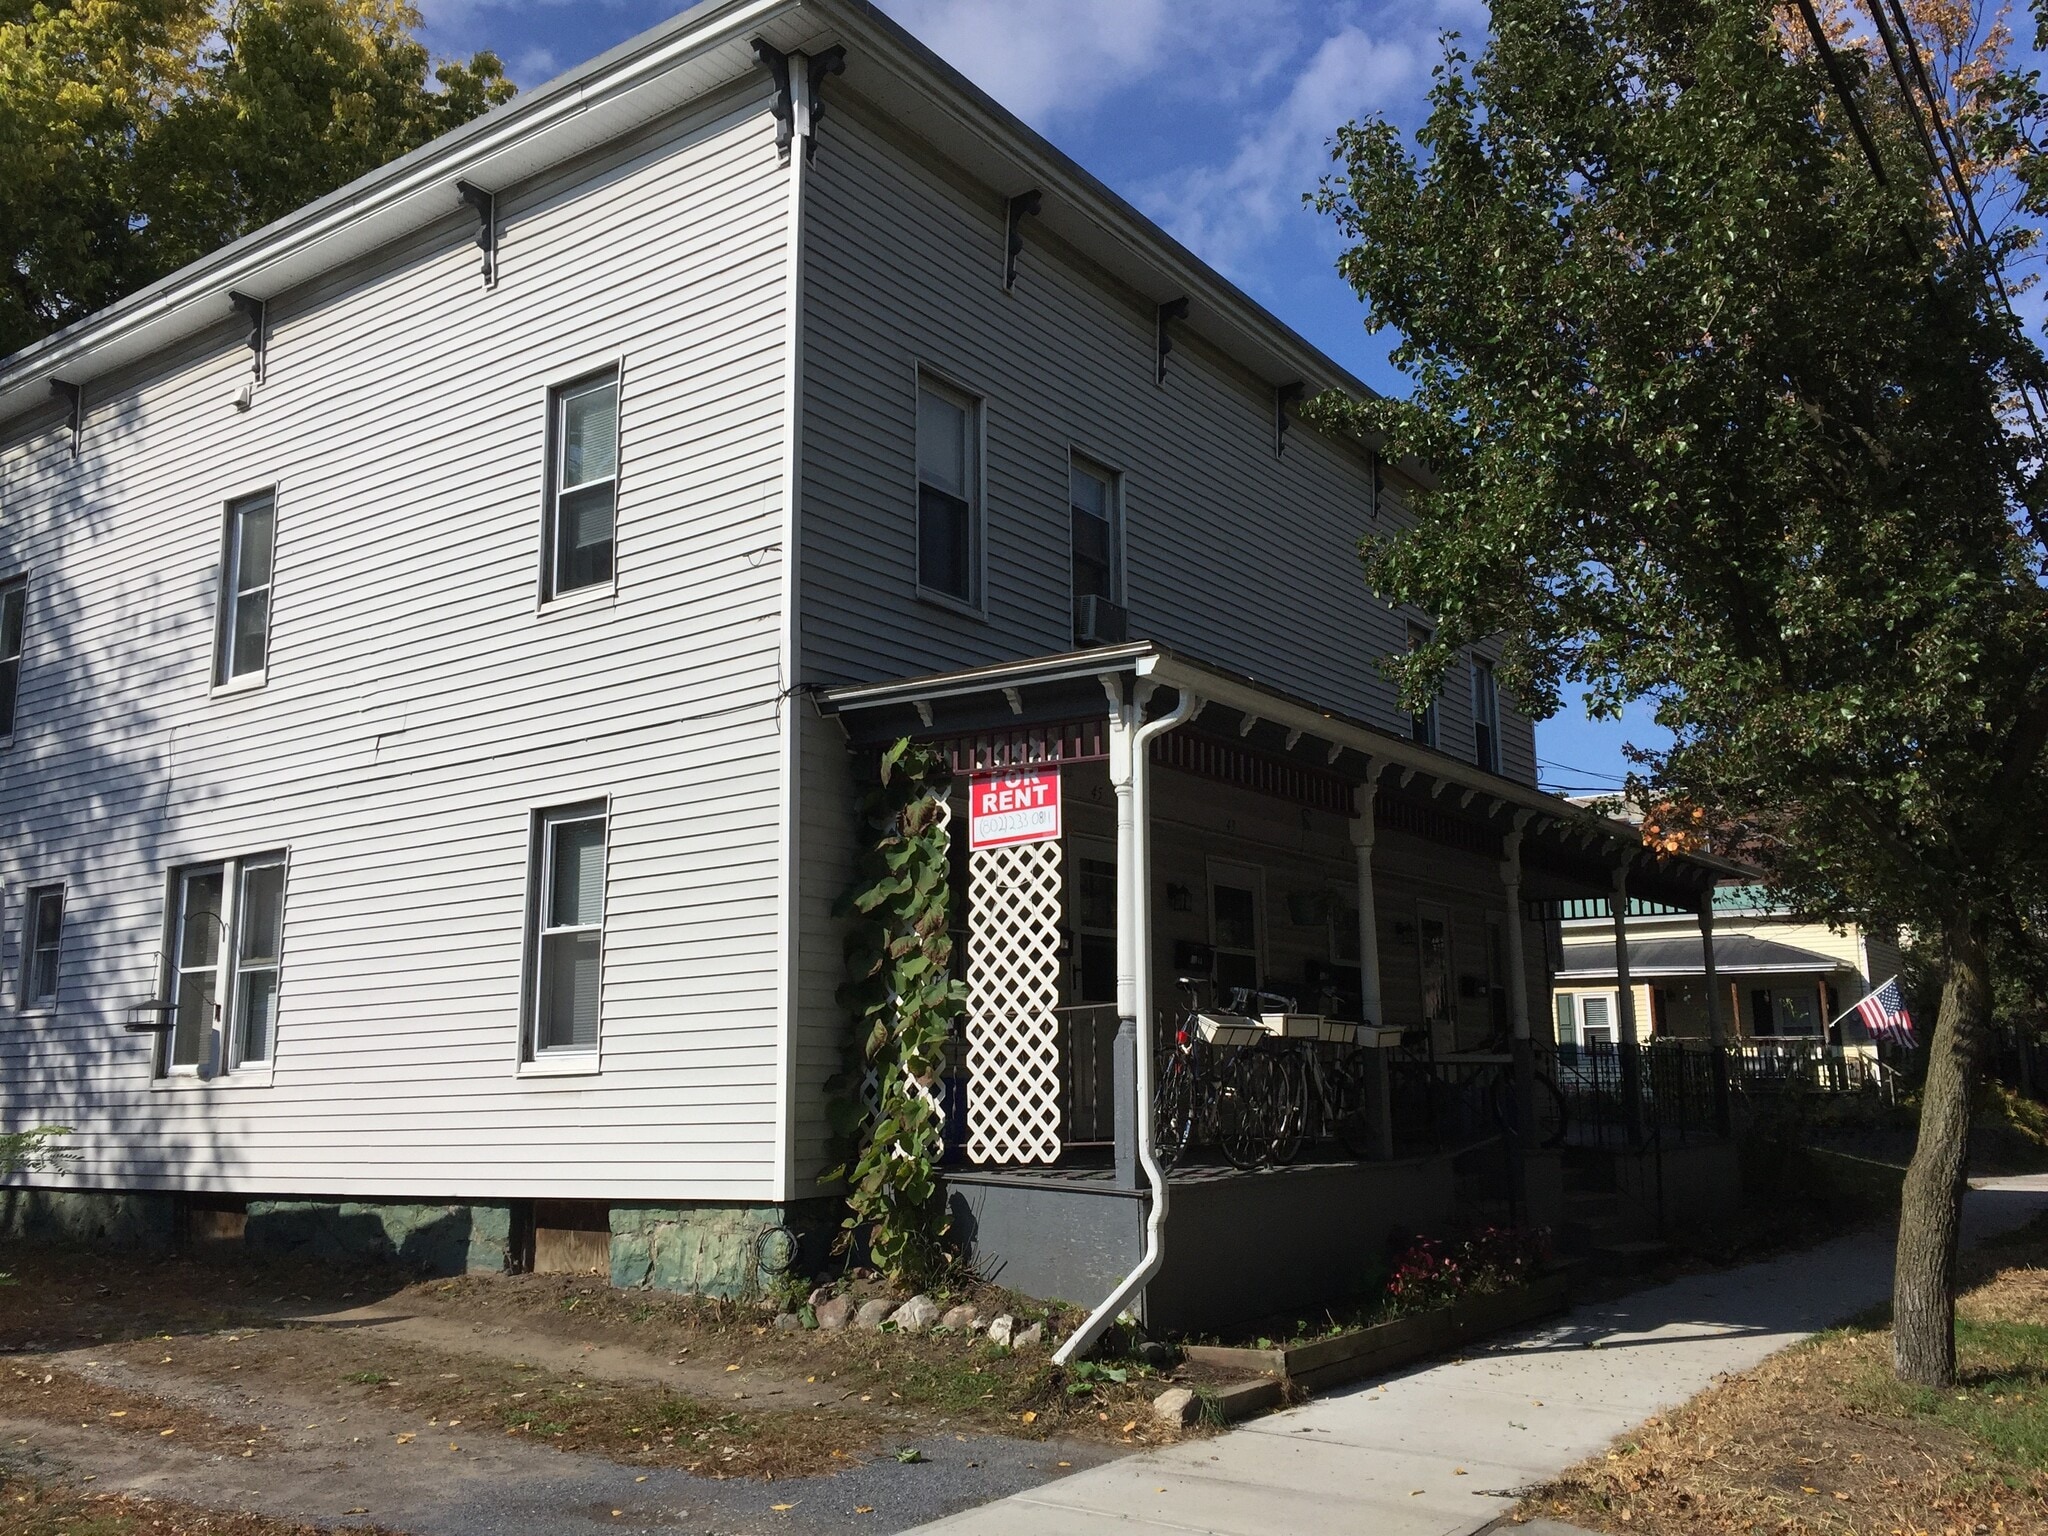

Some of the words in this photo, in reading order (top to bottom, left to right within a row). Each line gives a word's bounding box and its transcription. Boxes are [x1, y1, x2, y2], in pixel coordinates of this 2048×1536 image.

[990, 768, 1041, 791] FOR
[982, 784, 1048, 814] RENT
[1091, 785, 1103, 800] 45
